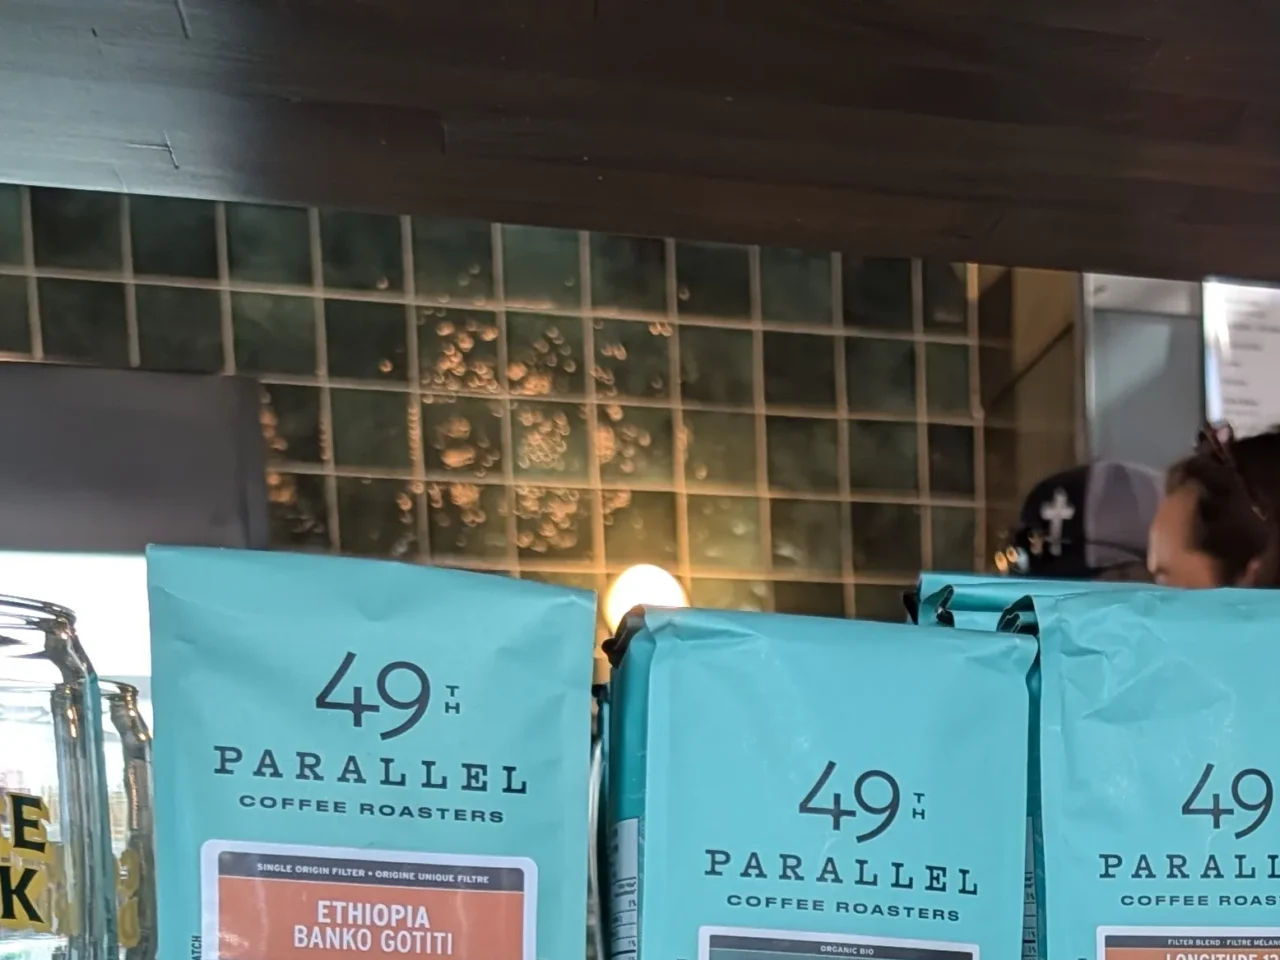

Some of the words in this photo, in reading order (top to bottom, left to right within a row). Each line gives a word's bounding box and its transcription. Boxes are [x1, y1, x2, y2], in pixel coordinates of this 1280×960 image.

[315, 651, 430, 741] 49
[214, 745, 528, 795] PARALLEL
[239, 795, 347, 814] COFFEE
[360, 803, 505, 824] ROASTERS
[799, 760, 901, 844] 49
[1182, 763, 1274, 840] 49
[257, 863, 293, 874] SINGLE
[295, 865, 330, 876] ORIGIN
[332, 867, 366, 878] FILTER
[375, 870, 416, 880] ORIGINE
[418, 872, 455, 883] UNIQUE
[457, 874, 490, 884] FILTRE
[704, 849, 978, 896] PARALLEL
[317, 899, 431, 929] ETHIOPIA
[727, 894, 825, 912] COFFEE
[836, 902, 960, 922] ROASTERS
[1120, 895, 1209, 906] COFFEE
[294, 925, 372, 950] BANKO
[380, 931, 453, 955] GOTITI
[820, 946, 858, 955] ORGANIC
[860, 948, 874, 956] BIO
